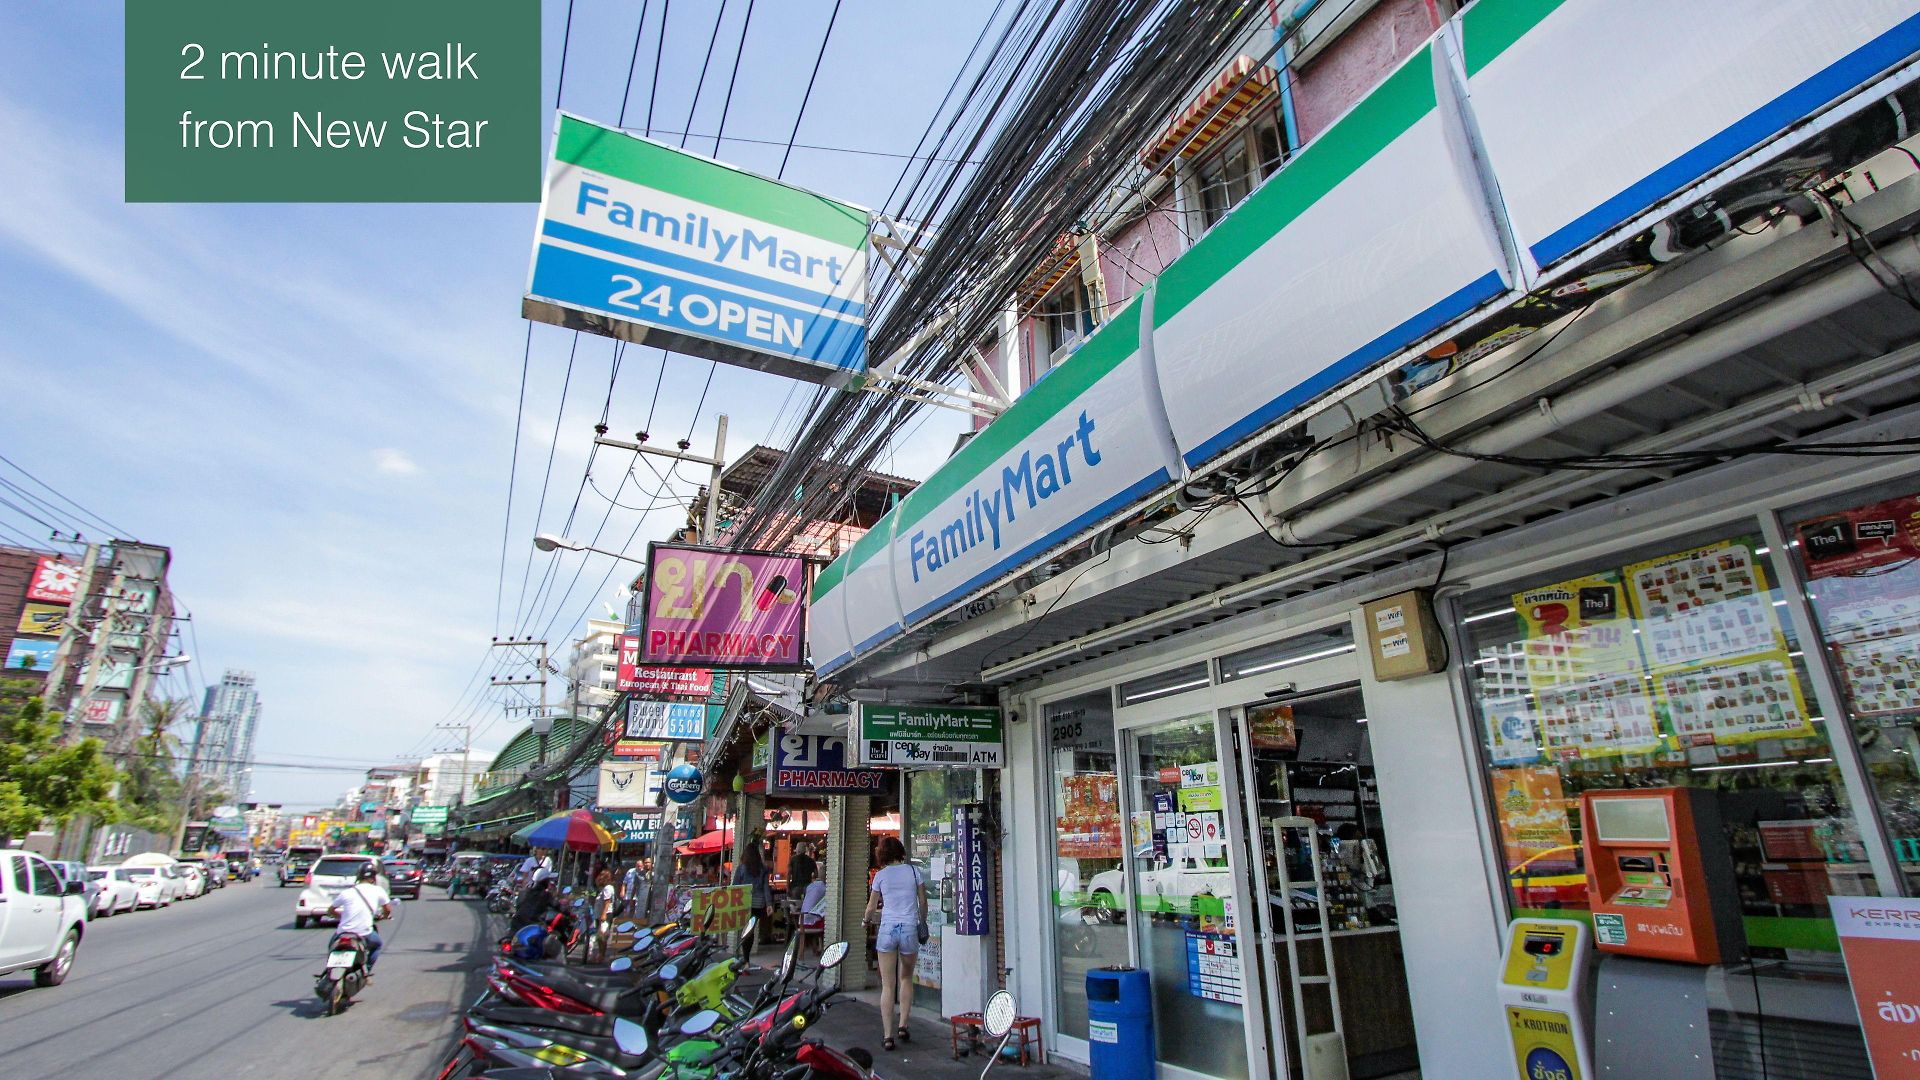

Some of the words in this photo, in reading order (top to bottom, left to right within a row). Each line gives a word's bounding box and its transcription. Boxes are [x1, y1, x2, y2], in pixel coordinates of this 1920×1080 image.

[575, 180, 843, 287] FamilyMart
[679, 294, 803, 349] OPEN
[909, 408, 1102, 584] FamilyMart
[654, 556, 755, 623] ยา
[649, 629, 795, 659] PHARMACY
[620, 679, 660, 690] European
[671, 682, 688, 691] Thai
[689, 683, 710, 692] Food
[634, 667, 698, 682] Restaurant
[898, 711, 969, 730] FamilyMart
[1052, 722, 1083, 741] 2905
[780, 734, 848, 768] ยา
[972, 751, 997, 763] ATM
[667, 778, 701, 792] Carlsberg
[778, 769, 883, 789] PHARMACY
[957, 828, 965, 932] PHARMACY
[971, 827, 983, 931] PHARMACY
[699, 888, 744, 911] FOR
[1877, 990, 1920, 1024] ส่ง
[1523, 1018, 1568, 1035] KROTRON
